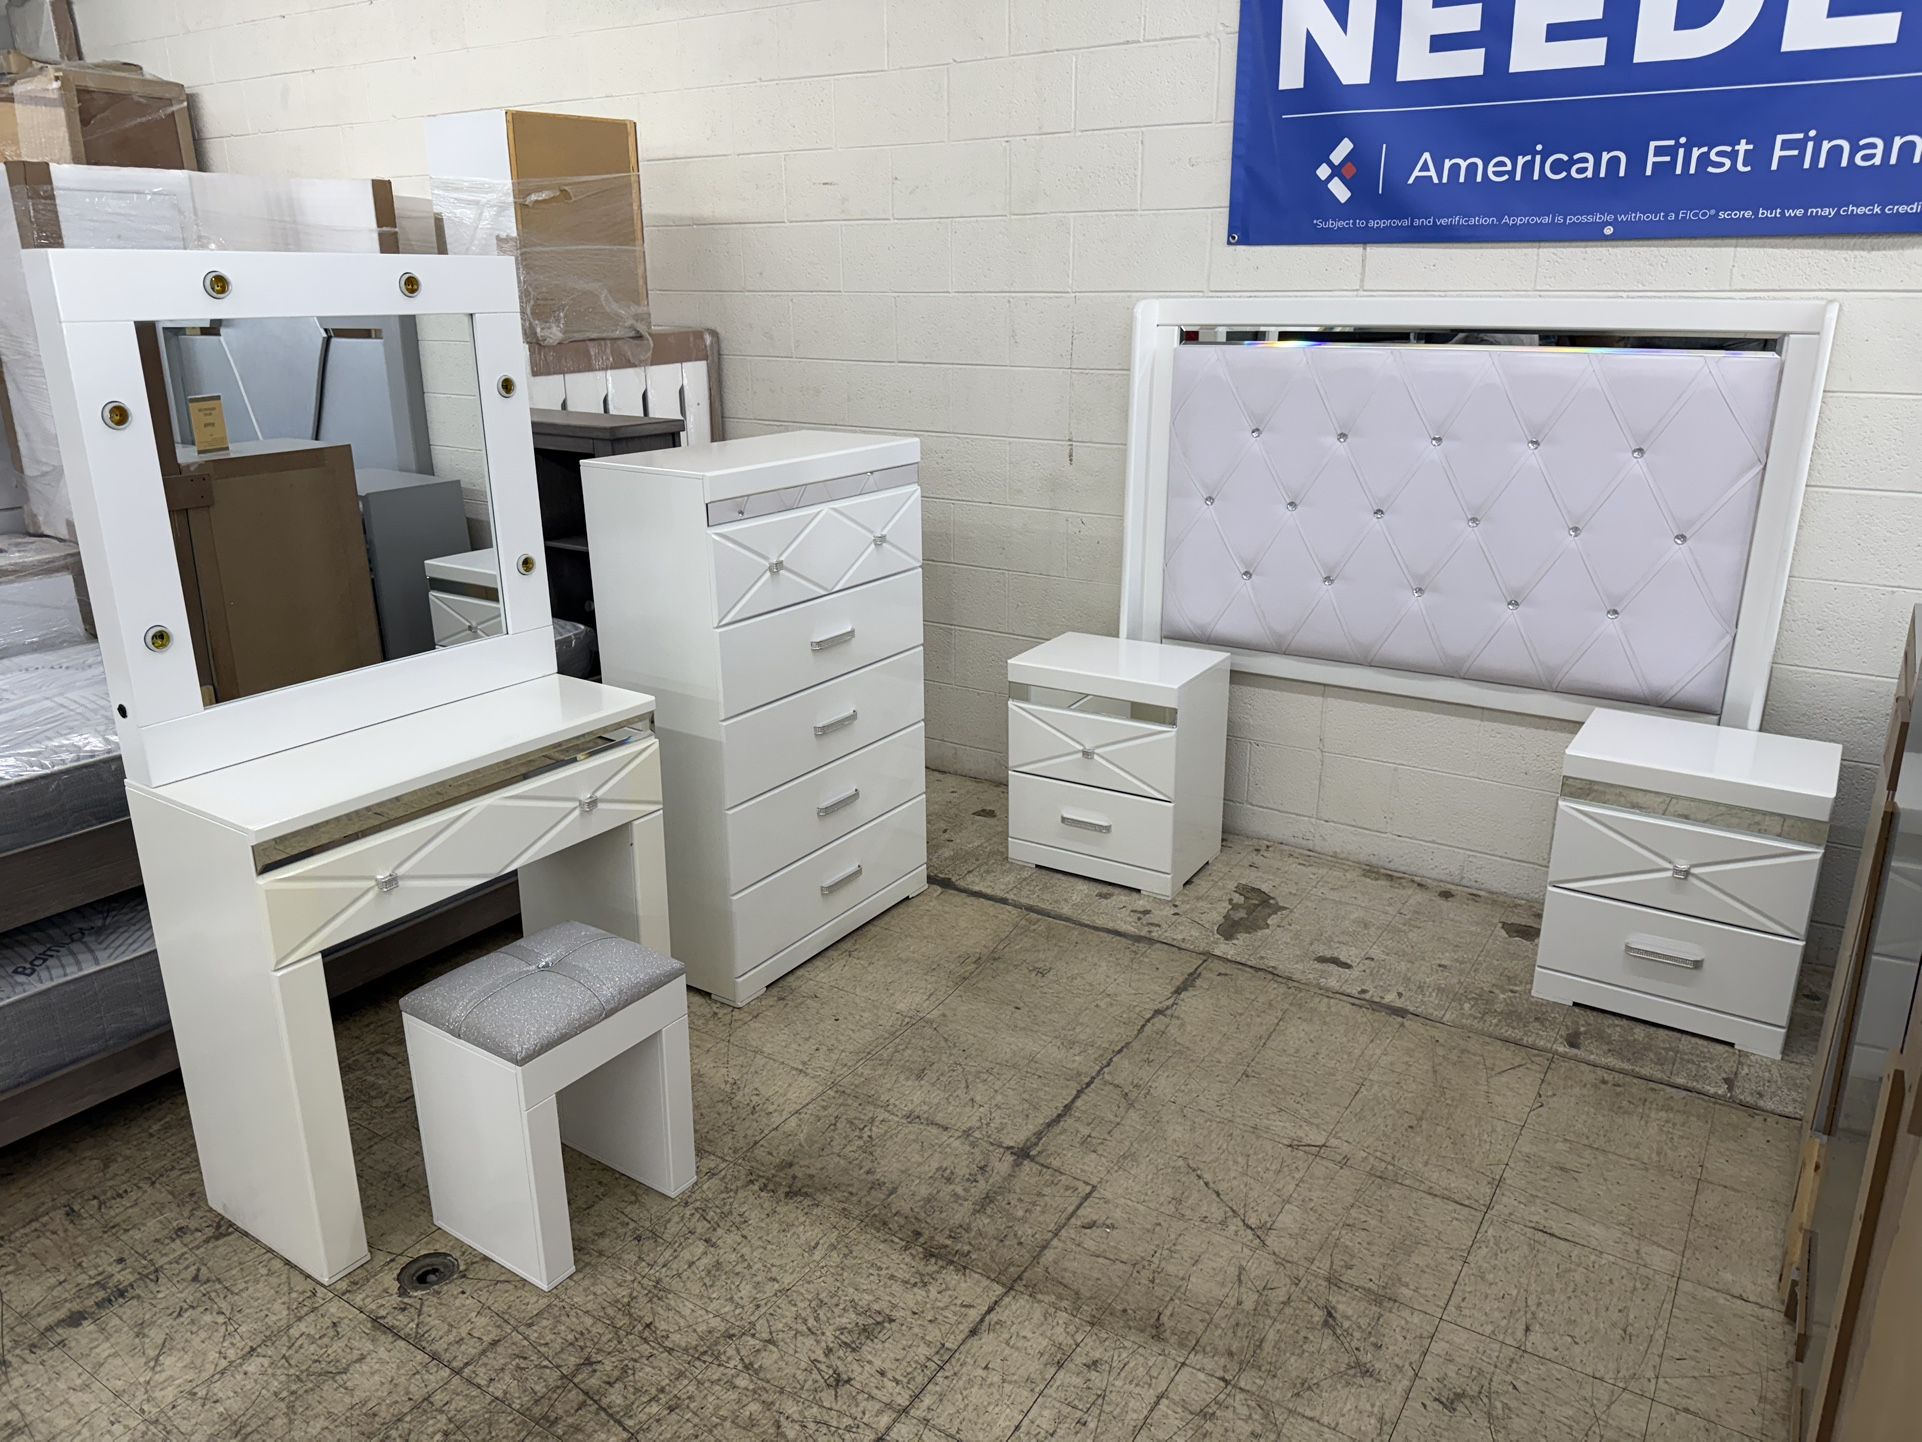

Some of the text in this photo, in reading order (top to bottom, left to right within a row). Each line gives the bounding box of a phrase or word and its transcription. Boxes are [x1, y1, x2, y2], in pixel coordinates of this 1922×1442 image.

[1406, 129, 1922, 185] American First Finan
[1356, 218, 1367, 228] to
[1367, 217, 1411, 230] approval
[1412, 216, 1434, 227] and
[1435, 214, 1499, 227] verification.
[1501, 213, 1552, 227] Approval
[1555, 213, 1564, 224] is
[1566, 212, 1615, 225] possible
[1617, 211, 1665, 222] without
[1667, 212, 1676, 221] a
[1717, 209, 1755, 220] score,
[1758, 207, 1782, 218] but
[1784, 208, 1805, 218] we
[1807, 207, 1838, 219] may
[1840, 203, 1882, 216] check
[1884, 201, 1922, 214] credi
